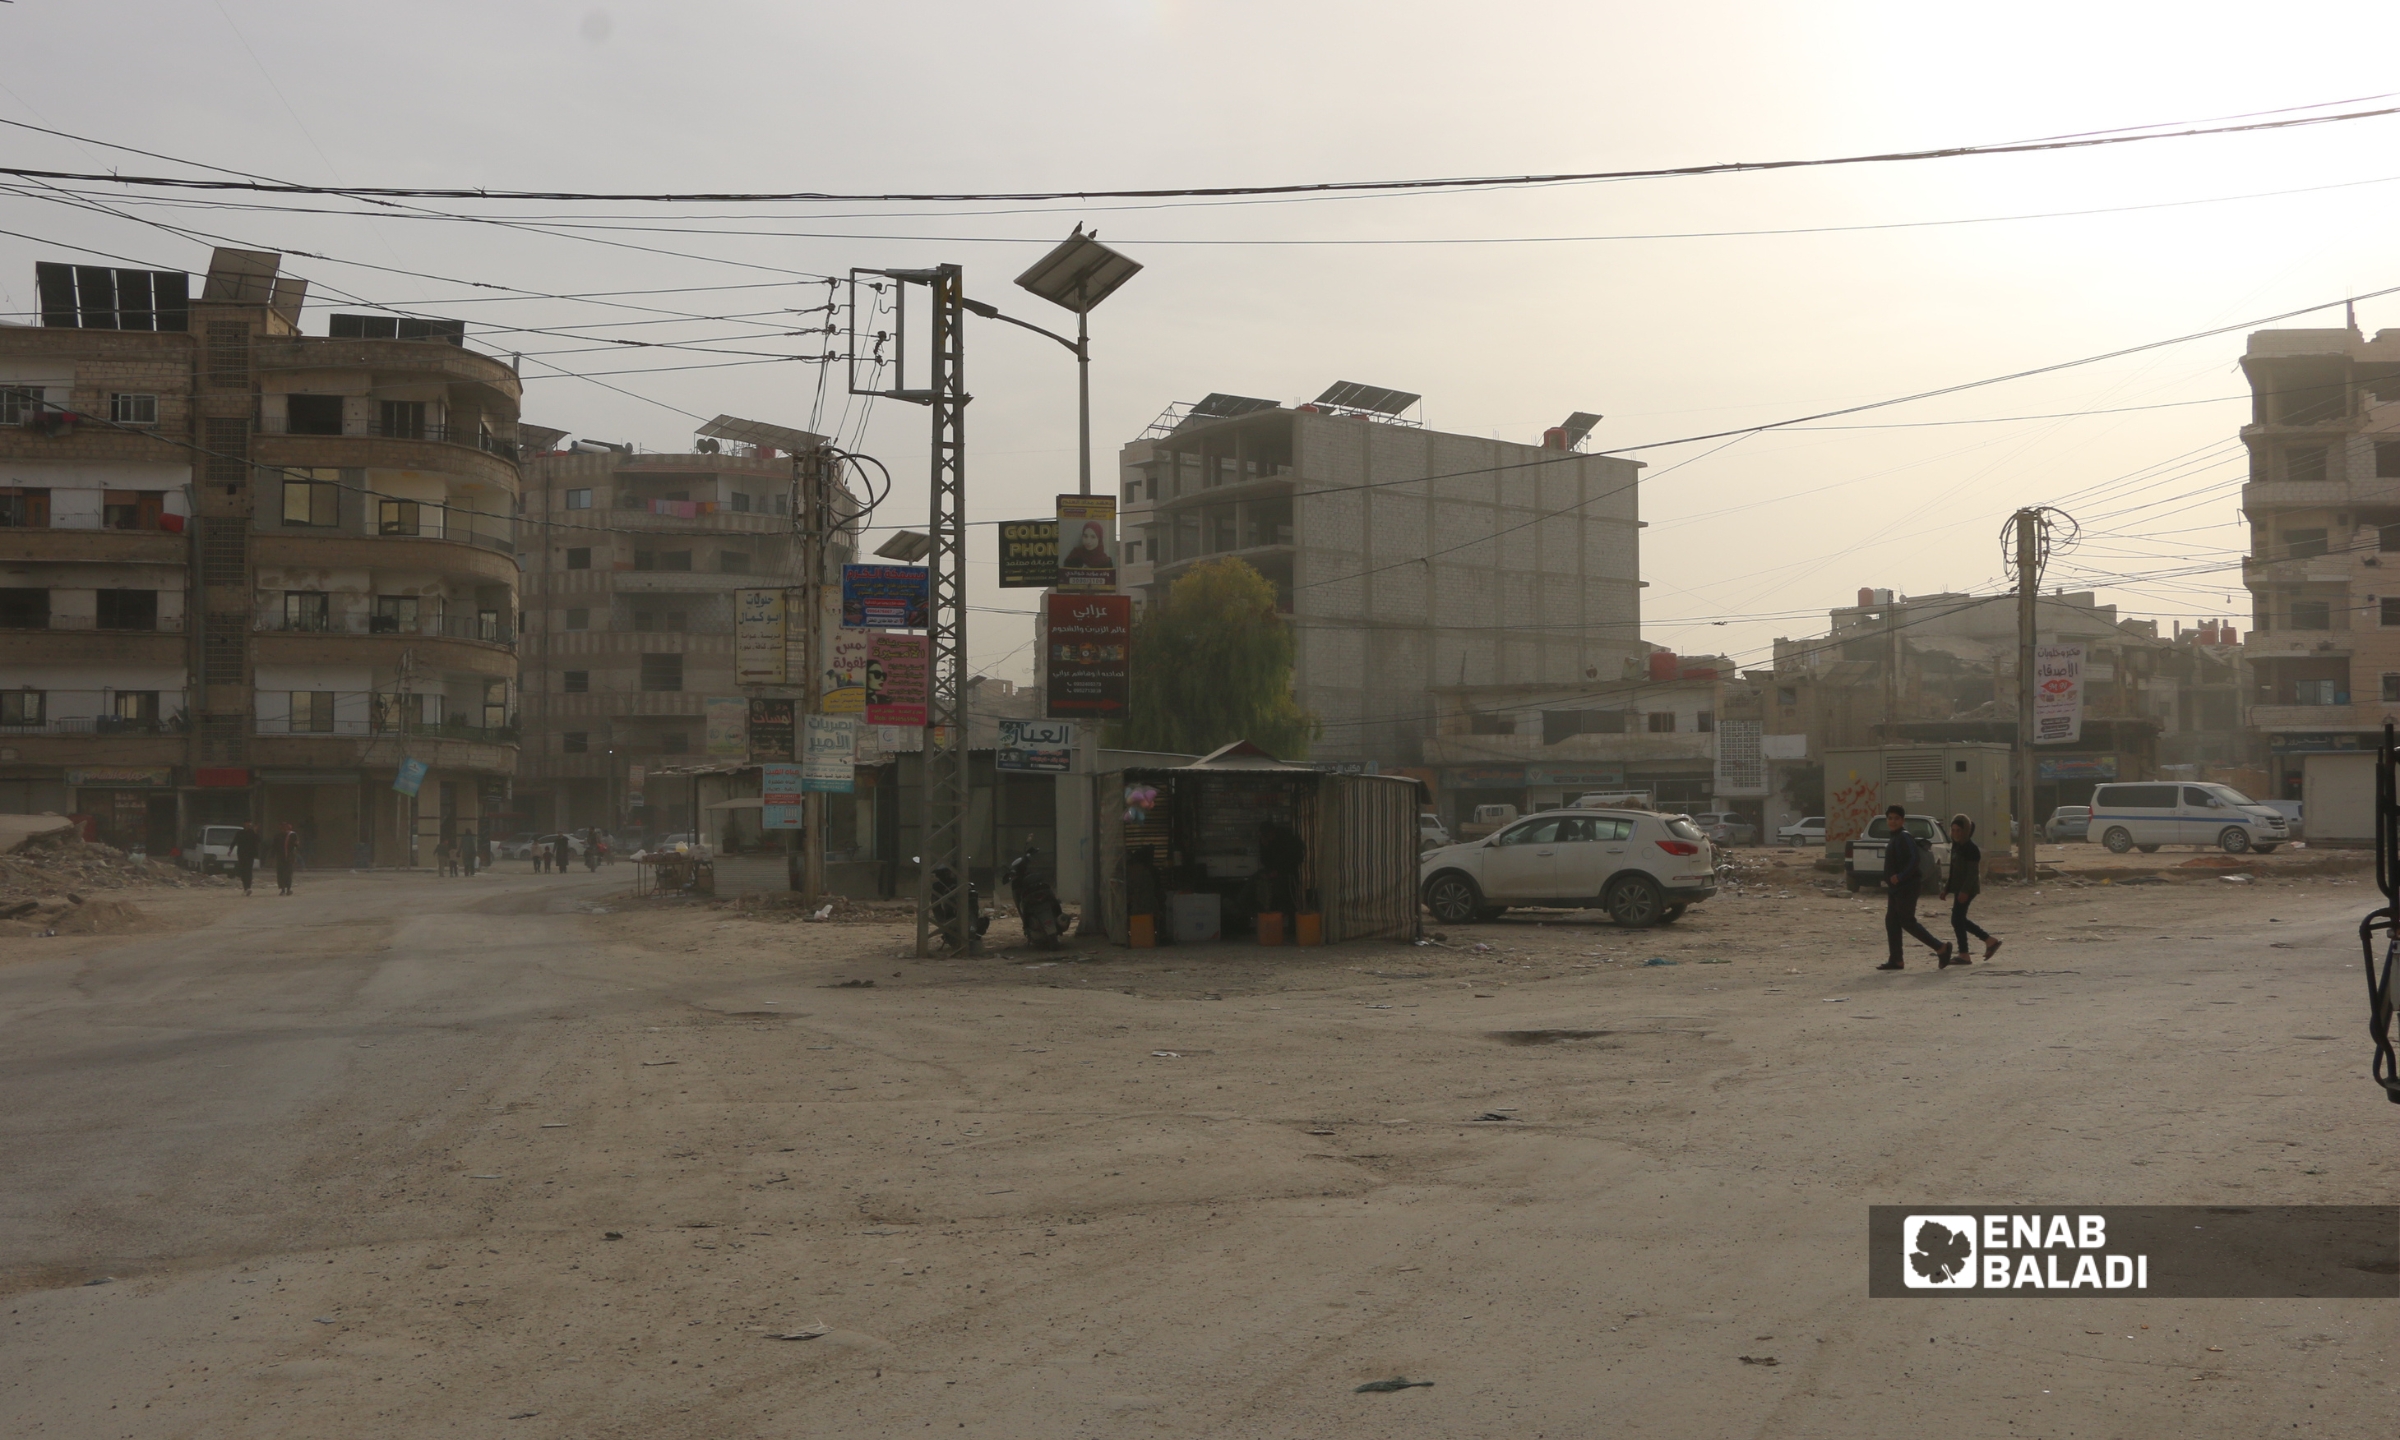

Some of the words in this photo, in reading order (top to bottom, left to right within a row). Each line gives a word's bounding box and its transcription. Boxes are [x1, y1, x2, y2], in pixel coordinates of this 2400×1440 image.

[1005, 524, 1058, 540] GOLDE
[1009, 542, 1058, 557] PHON
[884, 567, 926, 580] مسمكة
[746, 594, 774, 609] حلويات
[738, 611, 764, 625] كمال
[1073, 604, 1107, 621] عرابي
[836, 642, 867, 655] مس
[833, 656, 867, 672] طفولة
[2037, 661, 2079, 678] الأصدقاء
[752, 711, 792, 725] لمسات
[808, 717, 853, 734] بصريات
[808, 732, 851, 752] الأمير
